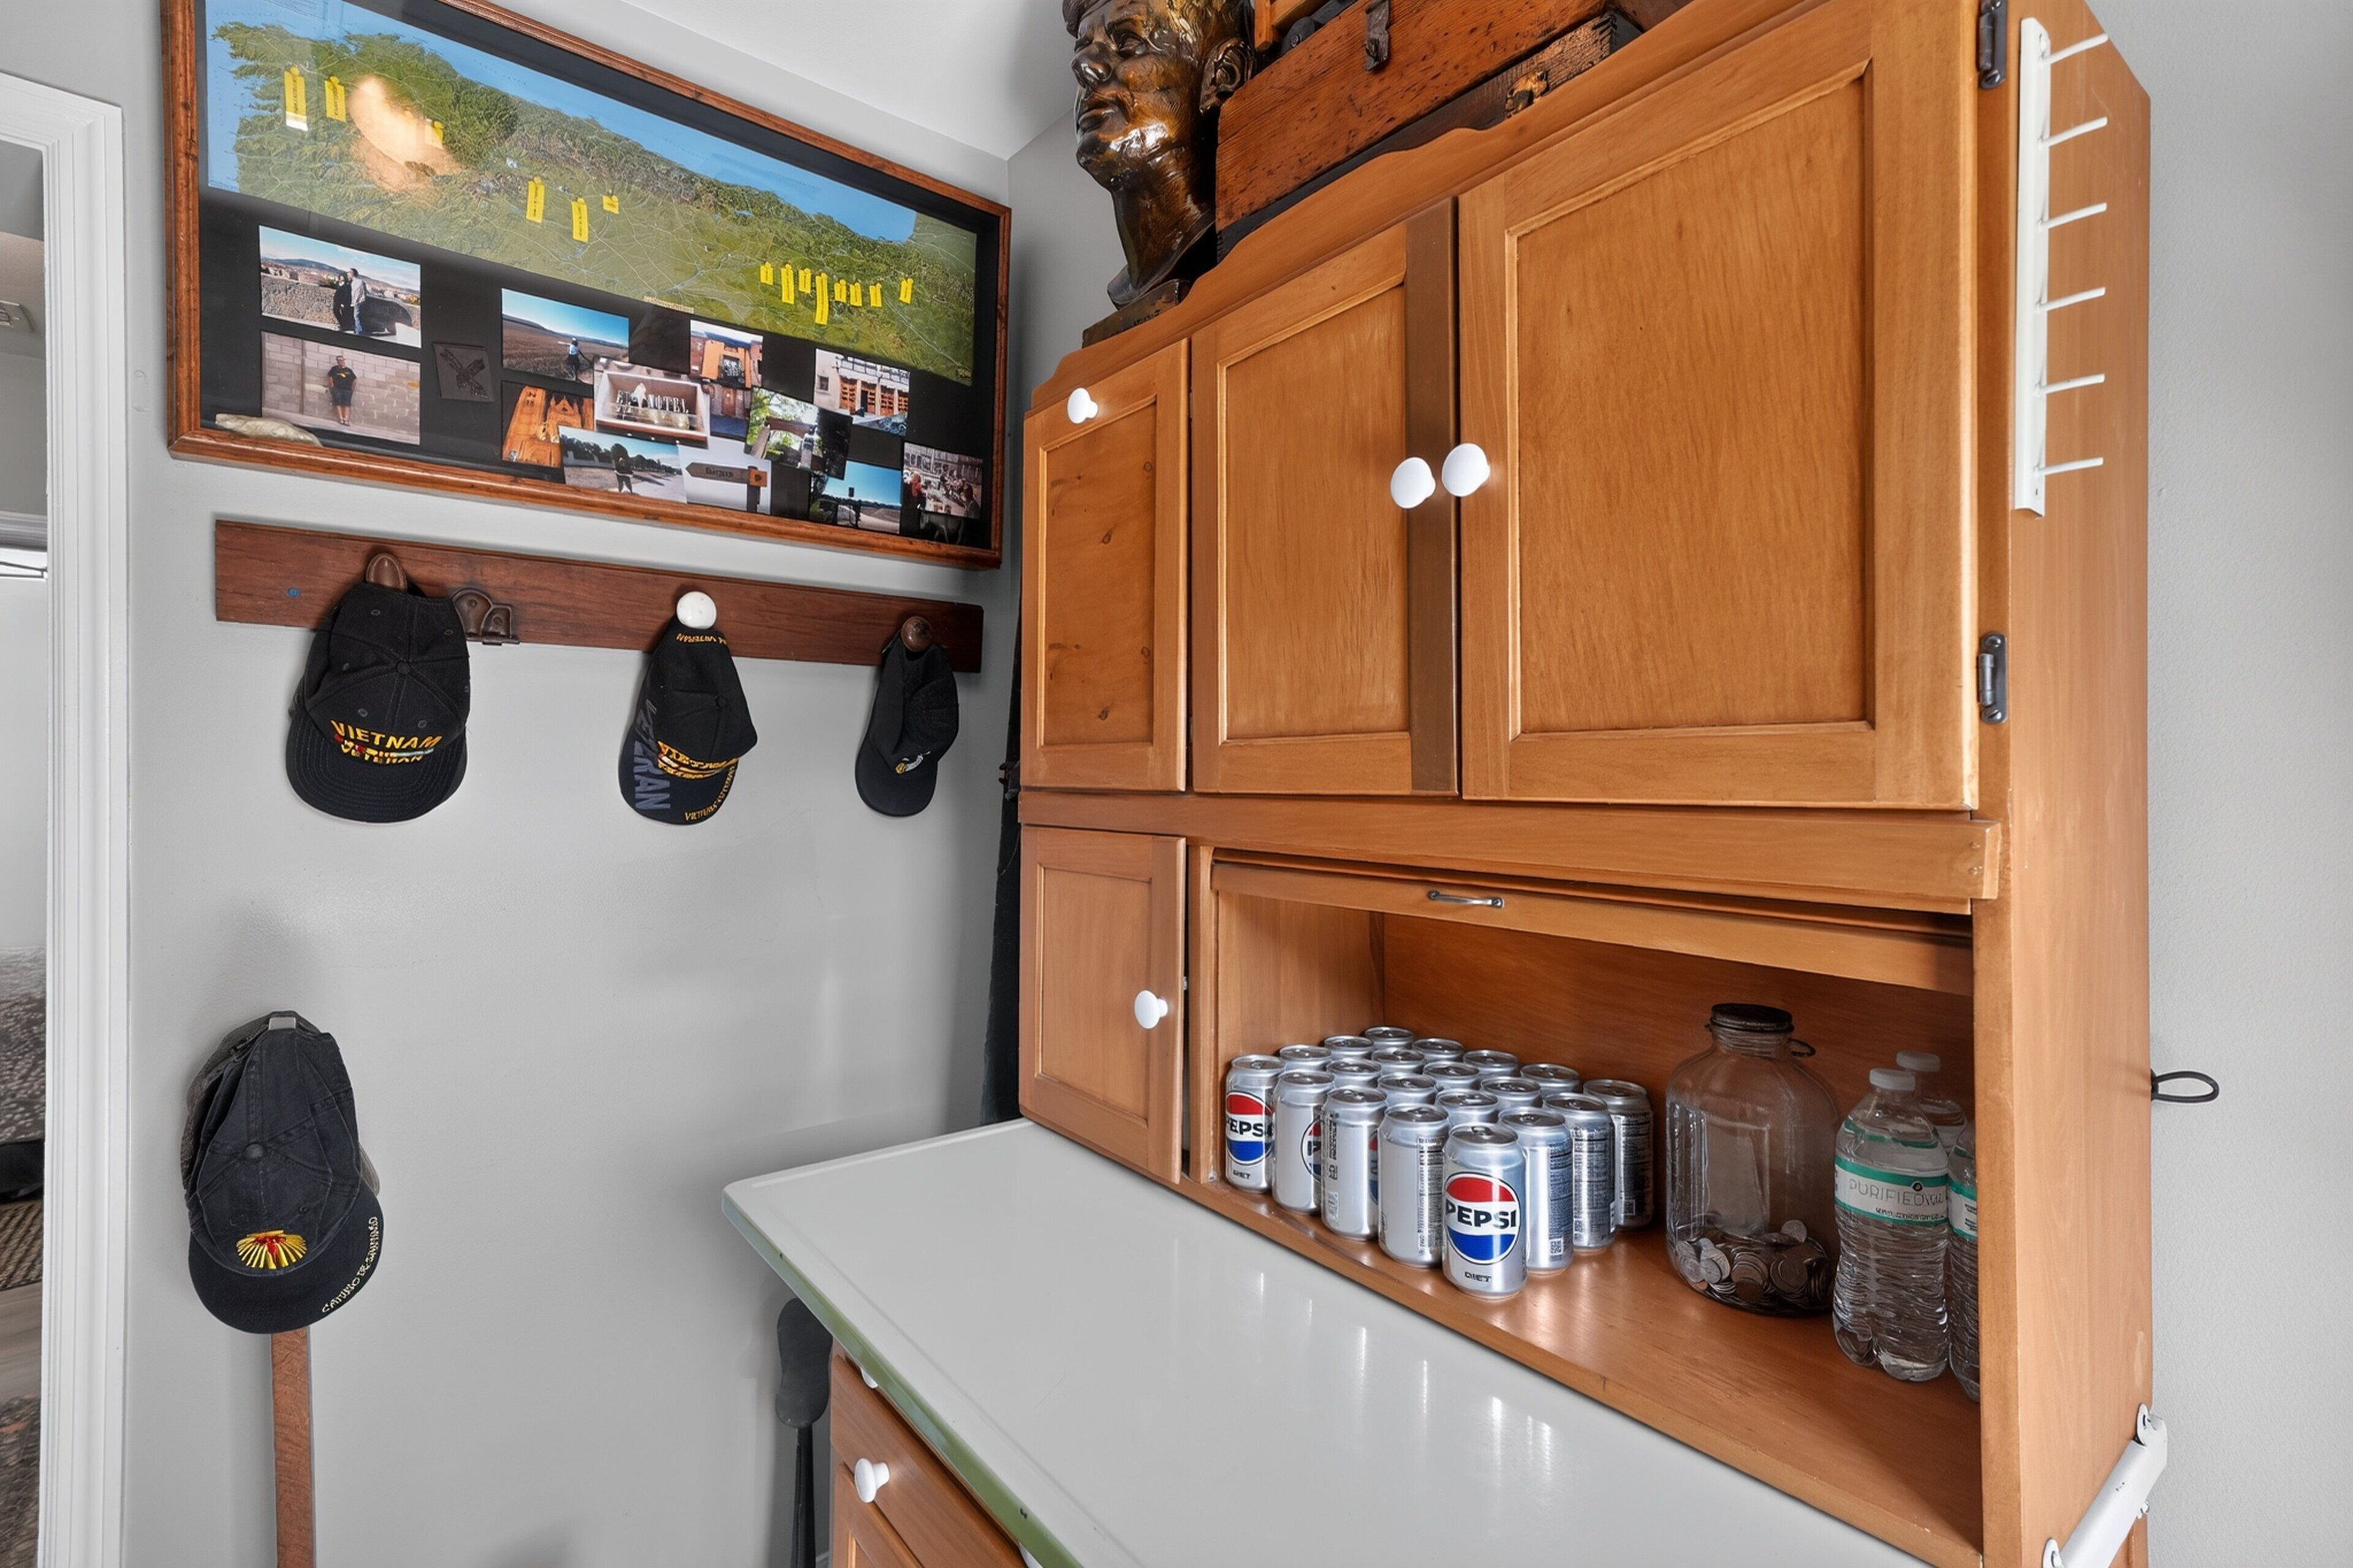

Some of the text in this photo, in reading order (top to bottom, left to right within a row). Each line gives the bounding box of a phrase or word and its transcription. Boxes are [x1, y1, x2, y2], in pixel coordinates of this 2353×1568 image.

[330, 719, 442, 749] VIETNAM
[1849, 1178, 1923, 1207] PURIFIED
[1446, 1199, 1517, 1230] PEPSI
[1464, 1271, 1491, 1282] DIET
